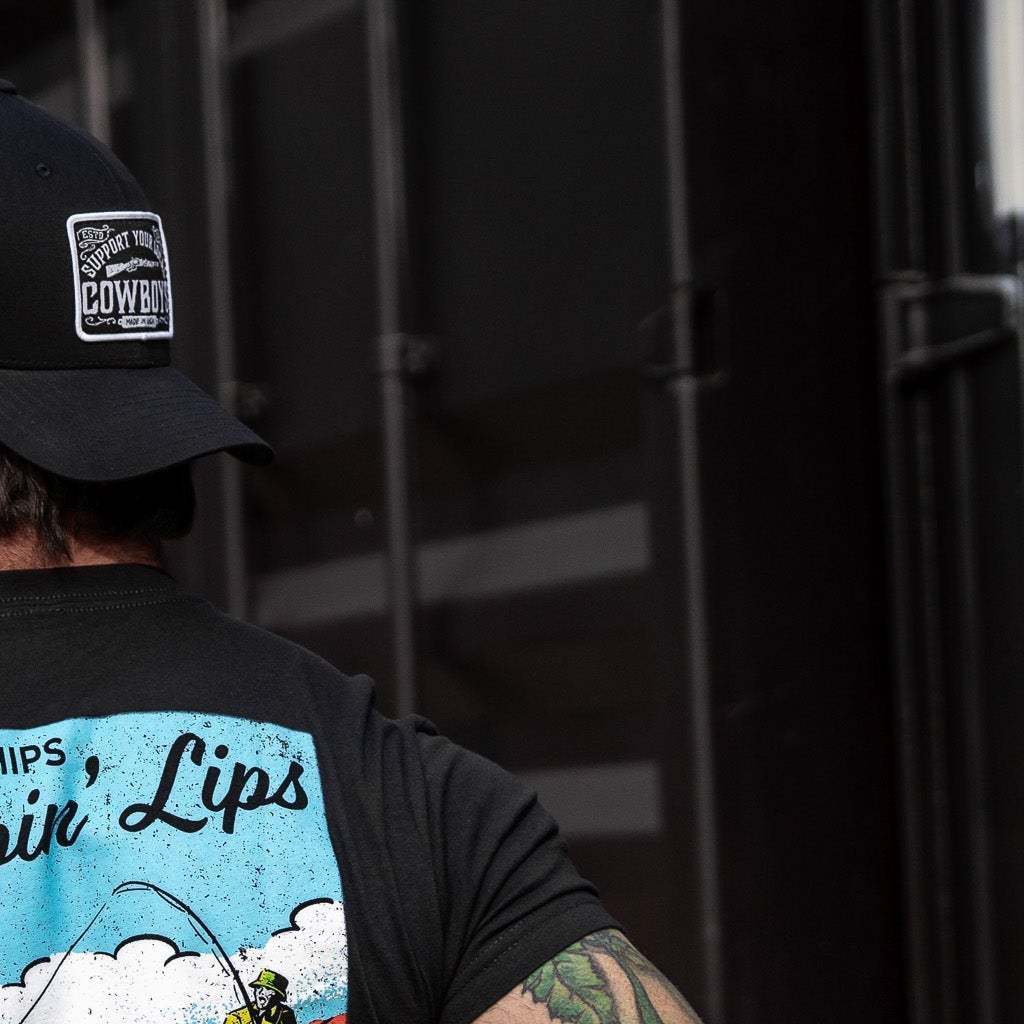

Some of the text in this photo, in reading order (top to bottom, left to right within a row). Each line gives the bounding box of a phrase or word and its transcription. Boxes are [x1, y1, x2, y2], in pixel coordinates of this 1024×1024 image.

[80, 231, 131, 278] SUPPORT
[131, 229, 153, 250] YOUR
[81, 230, 104, 240] ESTD
[118, 732, 309, 835] Lips
